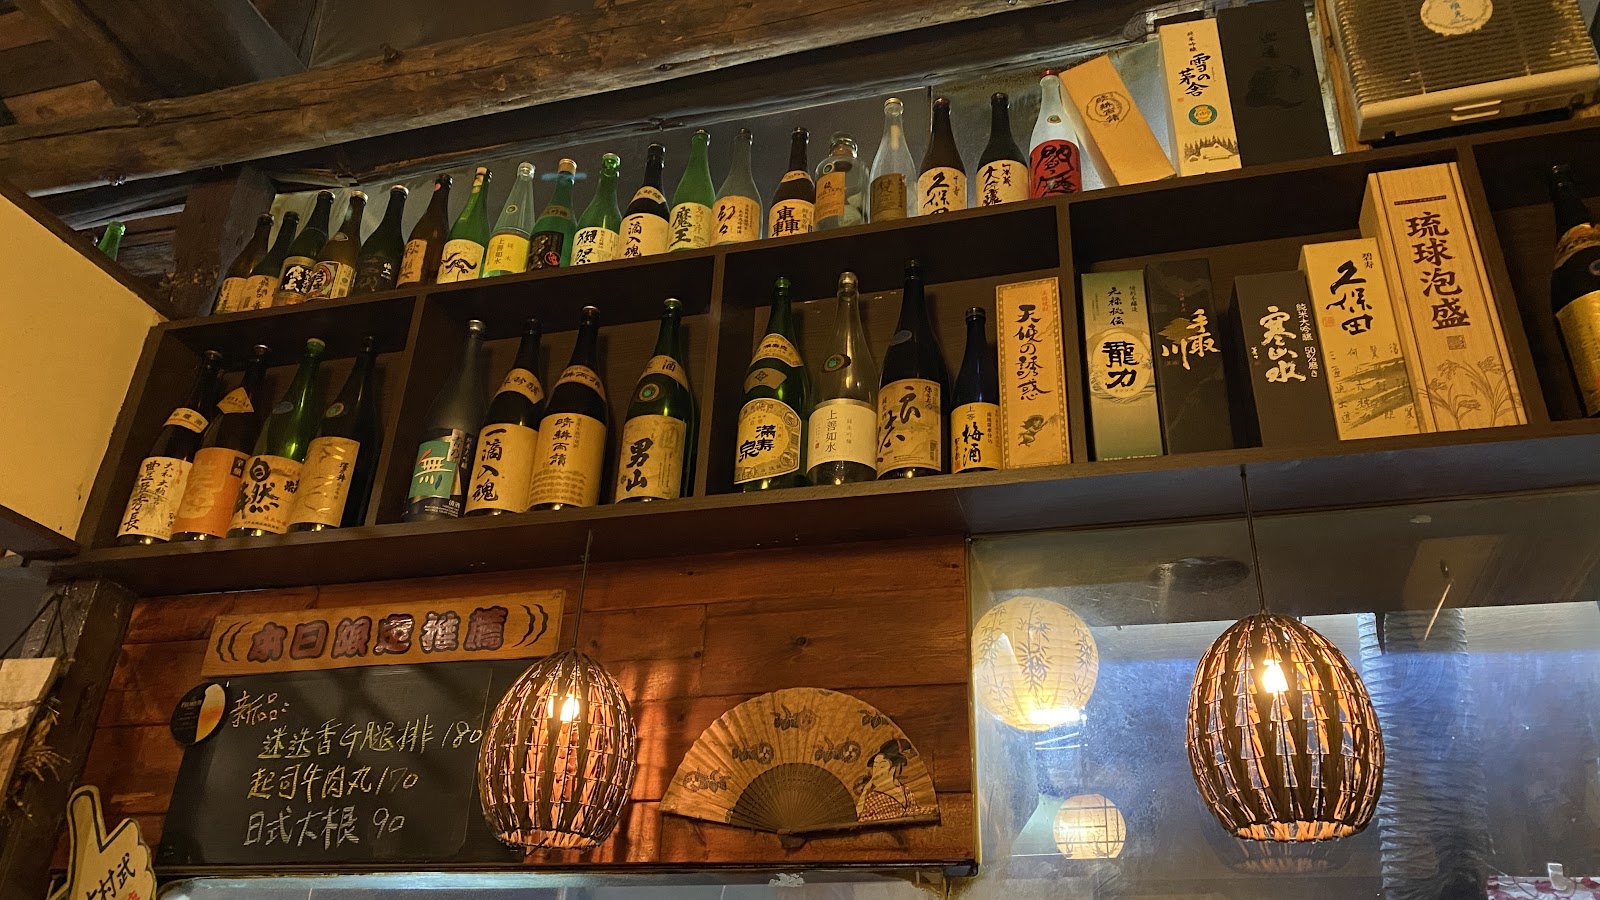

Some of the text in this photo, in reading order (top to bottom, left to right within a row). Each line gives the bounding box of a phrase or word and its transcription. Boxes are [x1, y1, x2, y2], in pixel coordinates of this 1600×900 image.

[1178, 53, 1211, 97] 雪の茅舎
[624, 215, 644, 258] 一滴入魂
[668, 206, 693, 249] 魔王
[772, 205, 801, 237] 轟
[575, 230, 598, 265] 獺祭
[1362, 252, 1374, 269] 碧寿
[1405, 211, 1472, 331] 琉球泡盛
[1325, 260, 1374, 336] 久保田
[1161, 308, 1222, 371] 手取川
[1259, 305, 1307, 383] 寒山水
[1295, 303, 1314, 341] 純米大吟醸
[1014, 304, 1052, 401] 天使の誘惑
[1101, 340, 1140, 389] 龍力
[738, 425, 776, 463] 満寿泉
[825, 409, 838, 452] 上善如水
[962, 421, 984, 467] 梅酒
[472, 428, 508, 502] 一滴入魂
[626, 437, 654, 492] 男山
[246, 606, 510, 664] 本日限定推薦
[441, 721, 483, 754] 180
[246, 762, 419, 804] 起司牛肉丸 170
[243, 805, 406, 850] 日式大根 90
